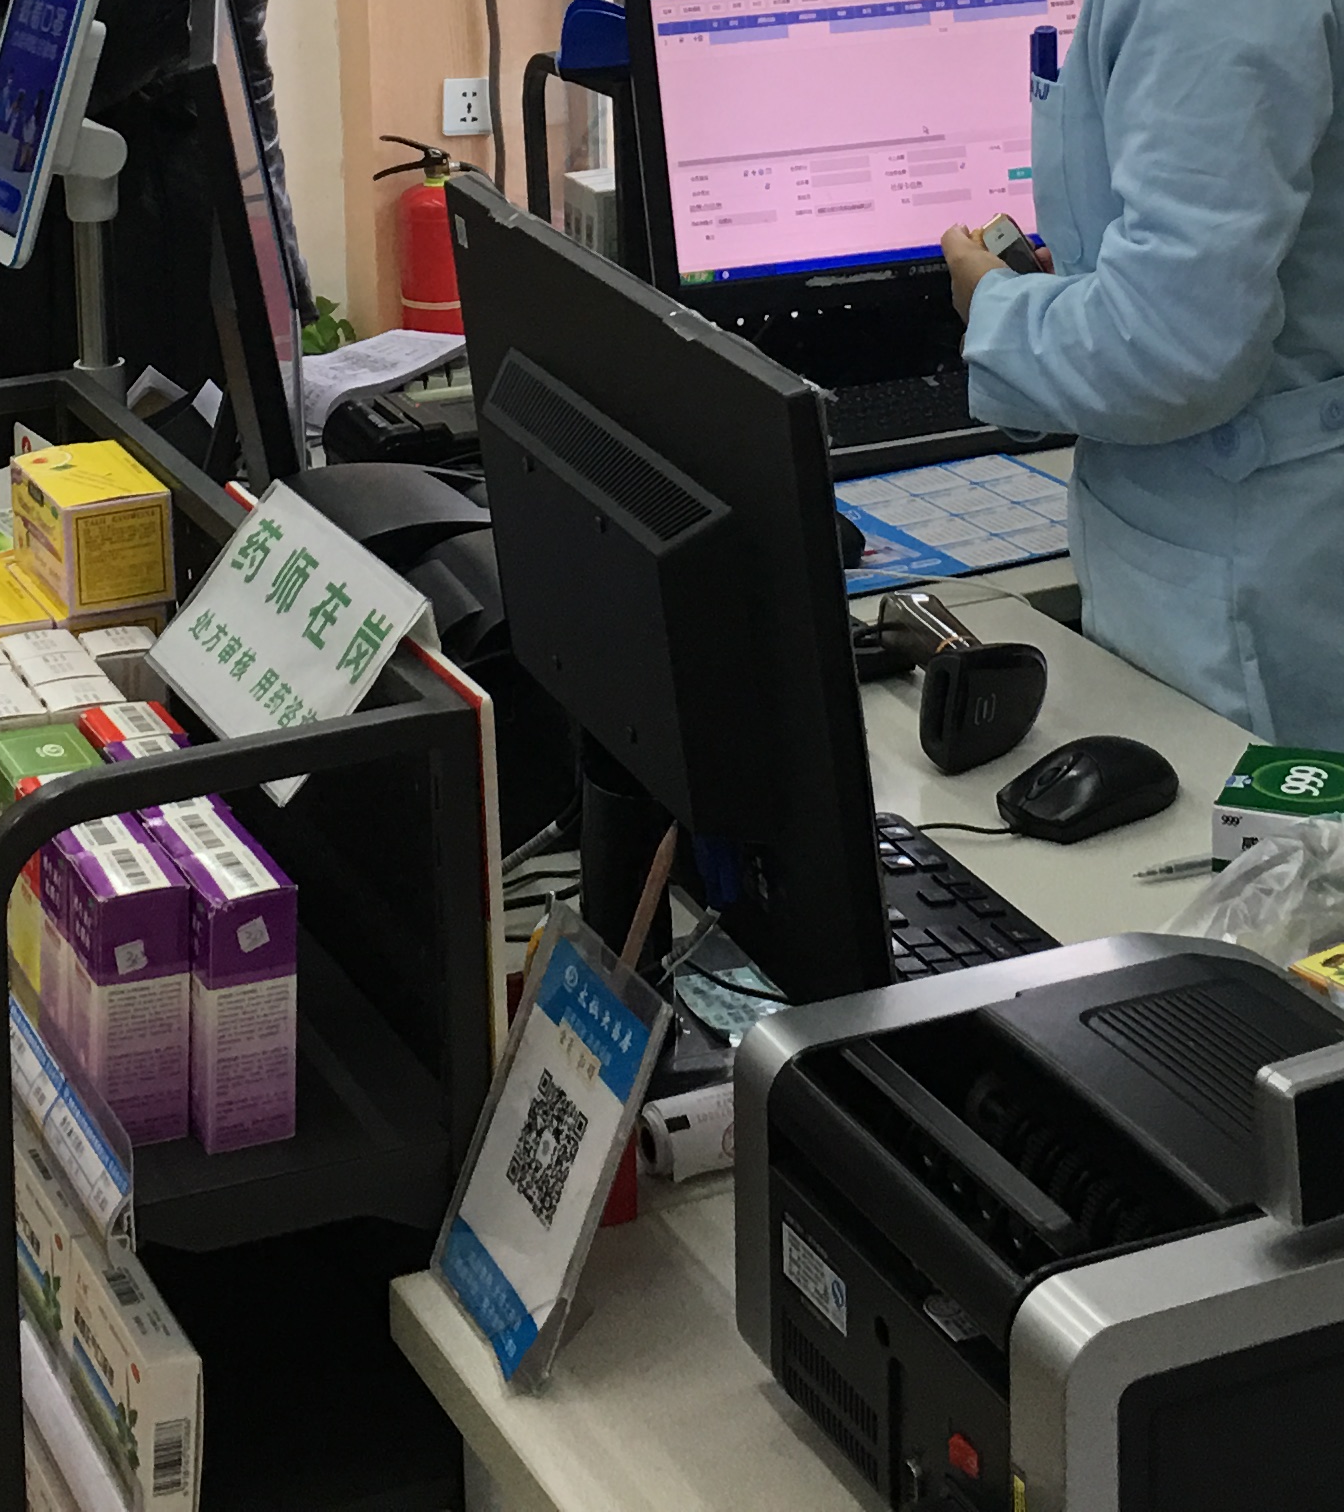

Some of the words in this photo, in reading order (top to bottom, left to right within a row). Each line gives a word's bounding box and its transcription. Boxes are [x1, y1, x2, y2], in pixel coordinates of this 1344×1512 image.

[230, 518, 393, 685] 药师在岗
[187, 609, 258, 682] 处方审核
[1280, 765, 1329, 797] 999
[1221, 814, 1240, 827] 999
